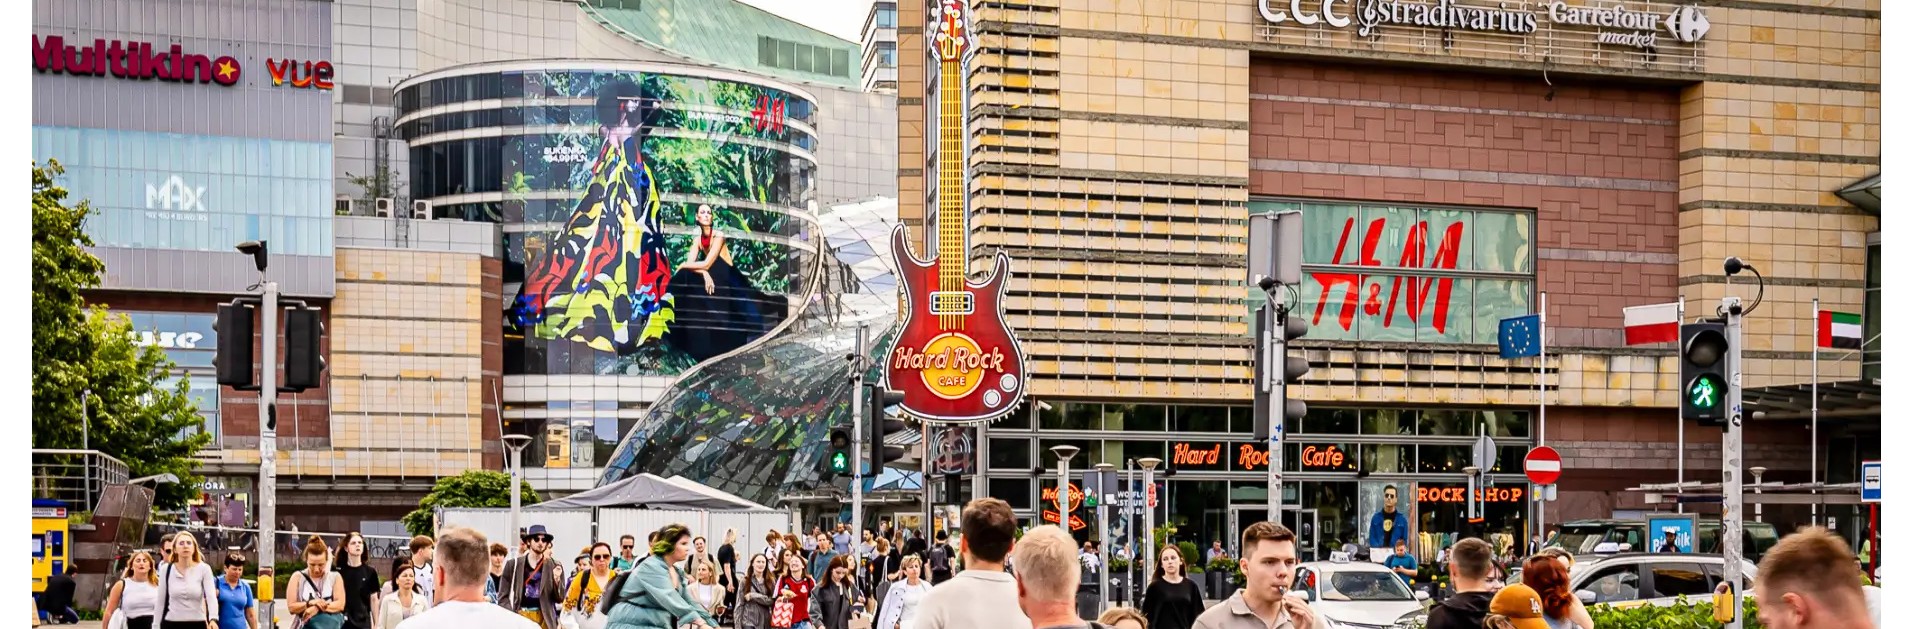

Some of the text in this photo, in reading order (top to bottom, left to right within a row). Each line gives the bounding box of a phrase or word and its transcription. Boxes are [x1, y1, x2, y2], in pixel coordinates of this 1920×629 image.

[1258, 0, 1350, 28] CCC
[1551, 1, 1660, 30] Carrefour
[1599, 30, 1656, 48] market
[32, 34, 241, 86] Multikino
[265, 57, 334, 90] vue
[1311, 216, 1464, 335] H&M
[895, 346, 1005, 373] Hard Rock
[938, 376, 966, 386] CAFE
[1173, 442, 1345, 470] Hard Roc Cafe
[1417, 487, 1522, 502] ROCK SHOP
[1529, 597, 1541, 614] LA
